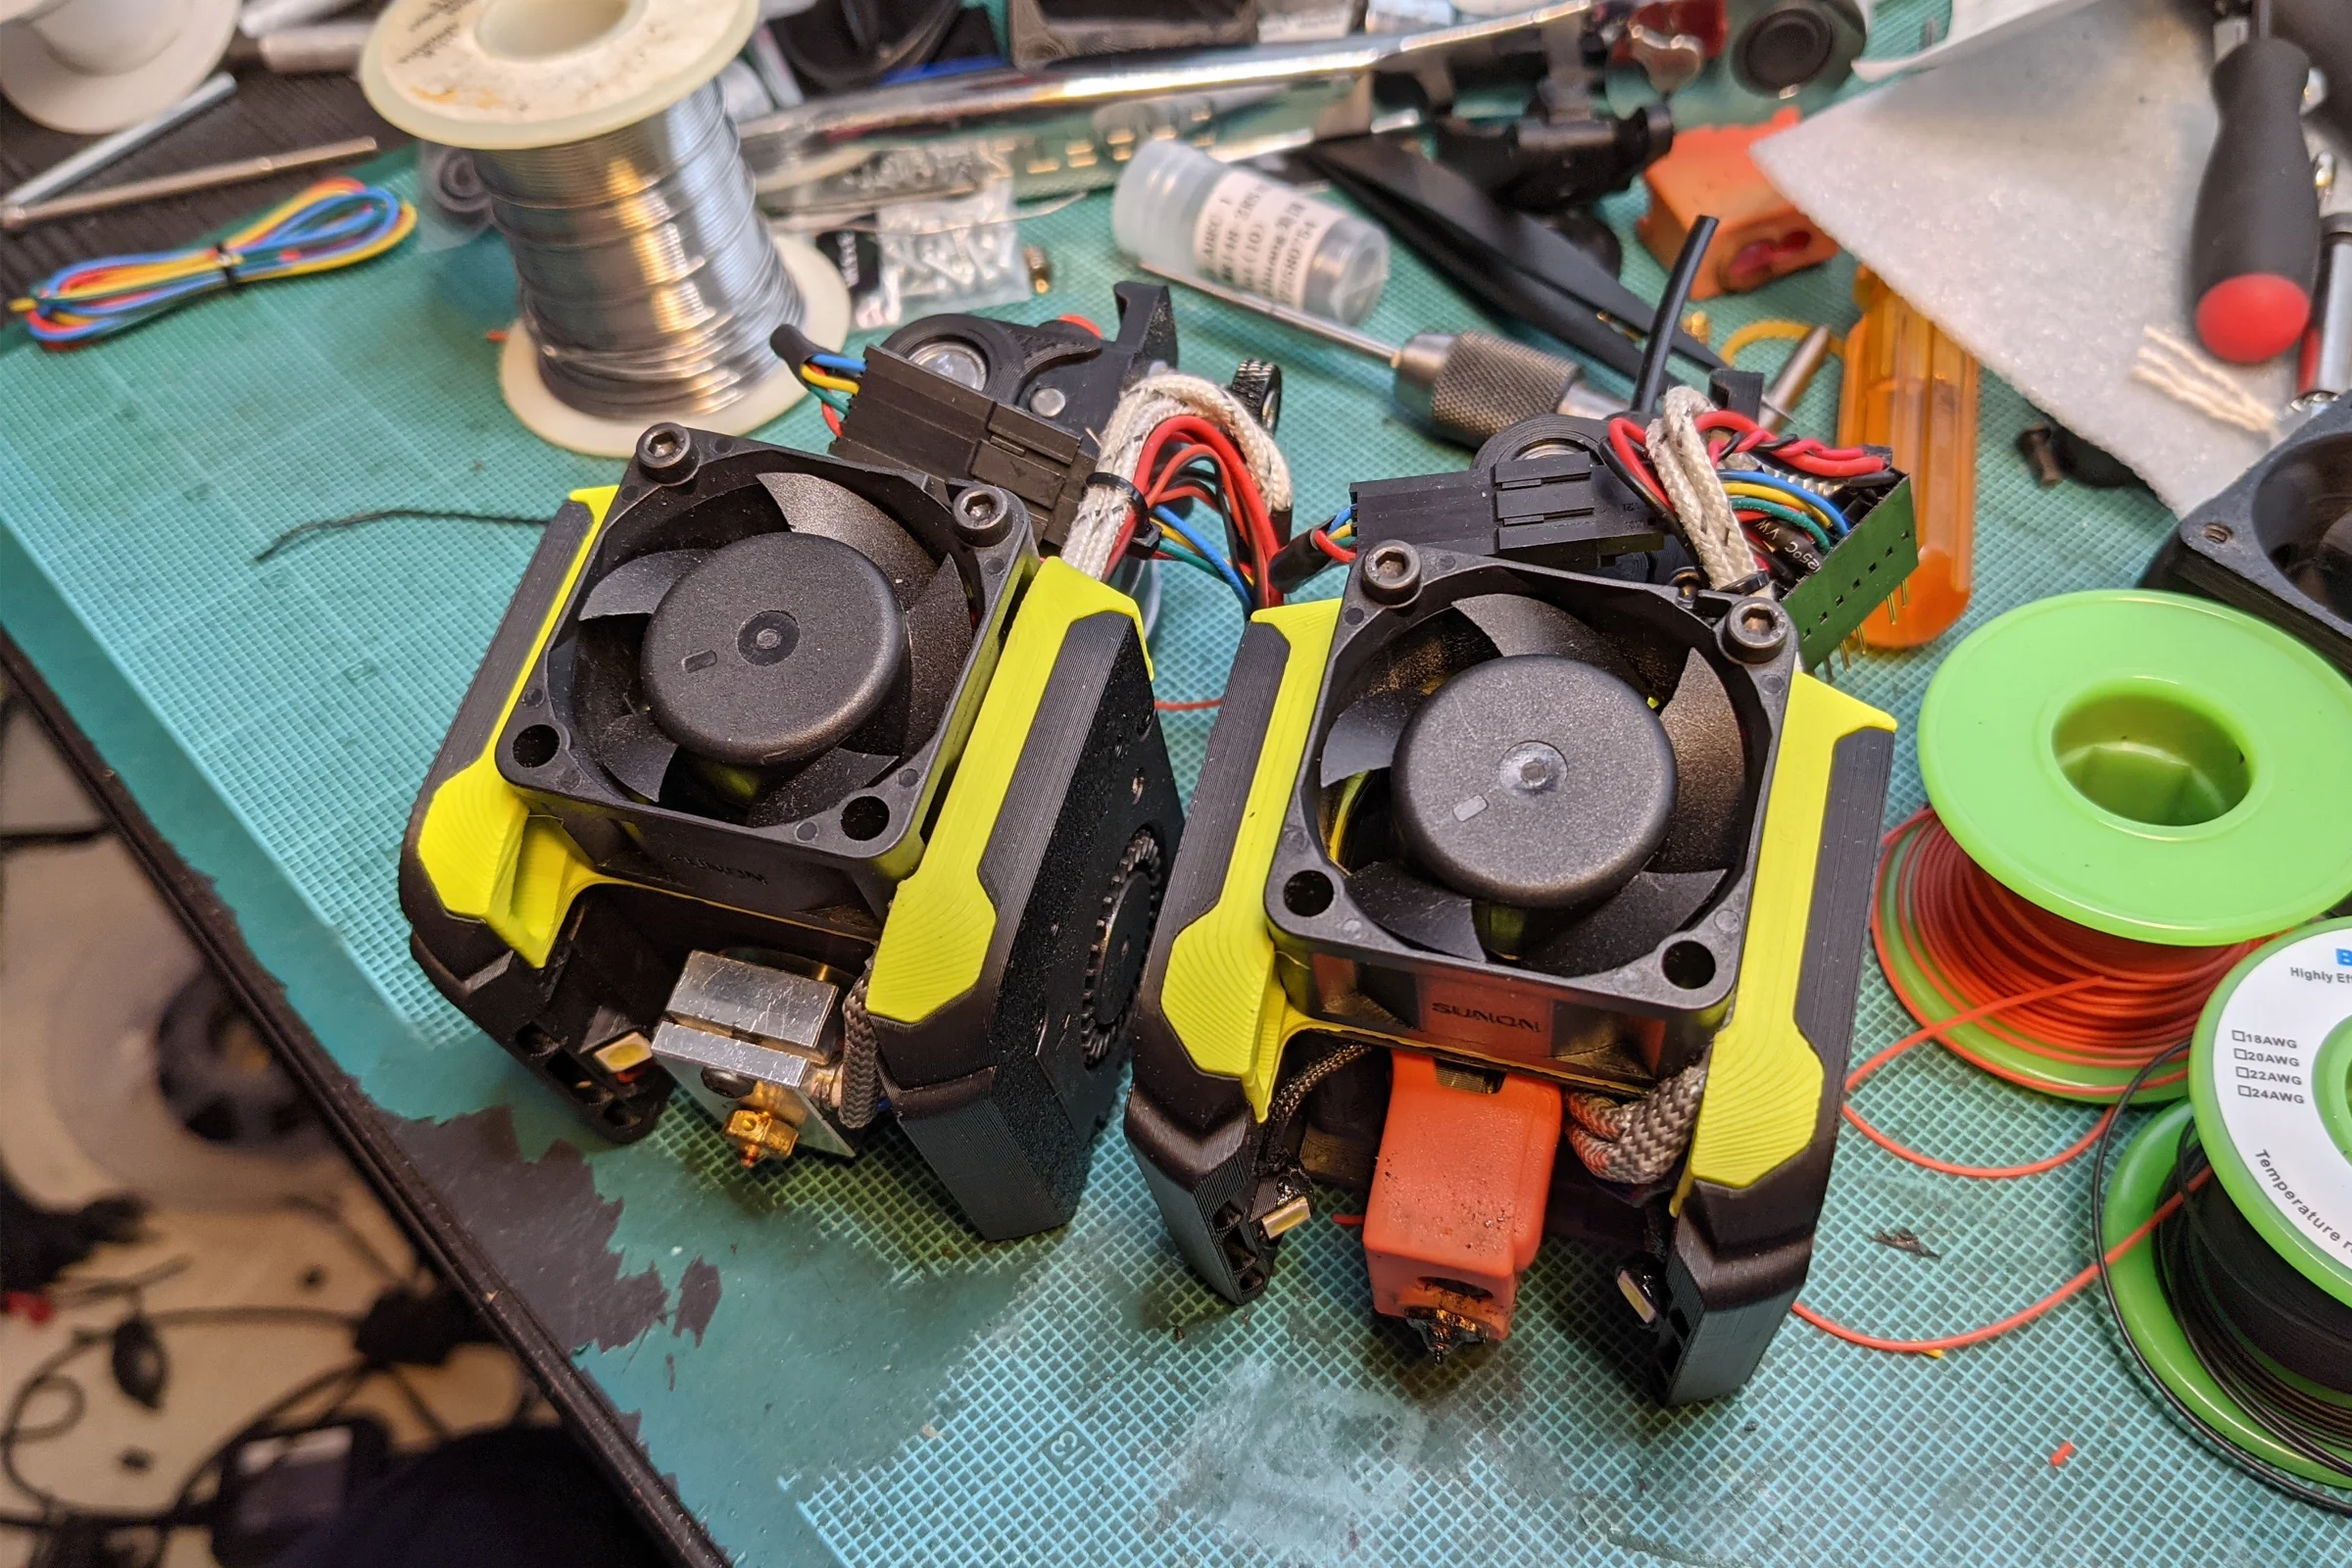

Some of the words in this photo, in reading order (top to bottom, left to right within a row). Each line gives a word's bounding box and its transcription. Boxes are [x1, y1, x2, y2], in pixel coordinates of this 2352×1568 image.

[2289, 966, 2332, 984] Highly
[2336, 973, 2352, 984] Ef
[1432, 1002, 1542, 1033] SUNON
[2245, 1034, 2297, 1049] 18AWG
[2247, 1052, 2300, 1067] 20AWG
[2249, 1069, 2302, 1085] 22AWG
[2251, 1088, 2304, 1103] 24AWG
[2255, 1149, 2340, 1242] Temperature
[1051, 1431, 1086, 1467] 13
